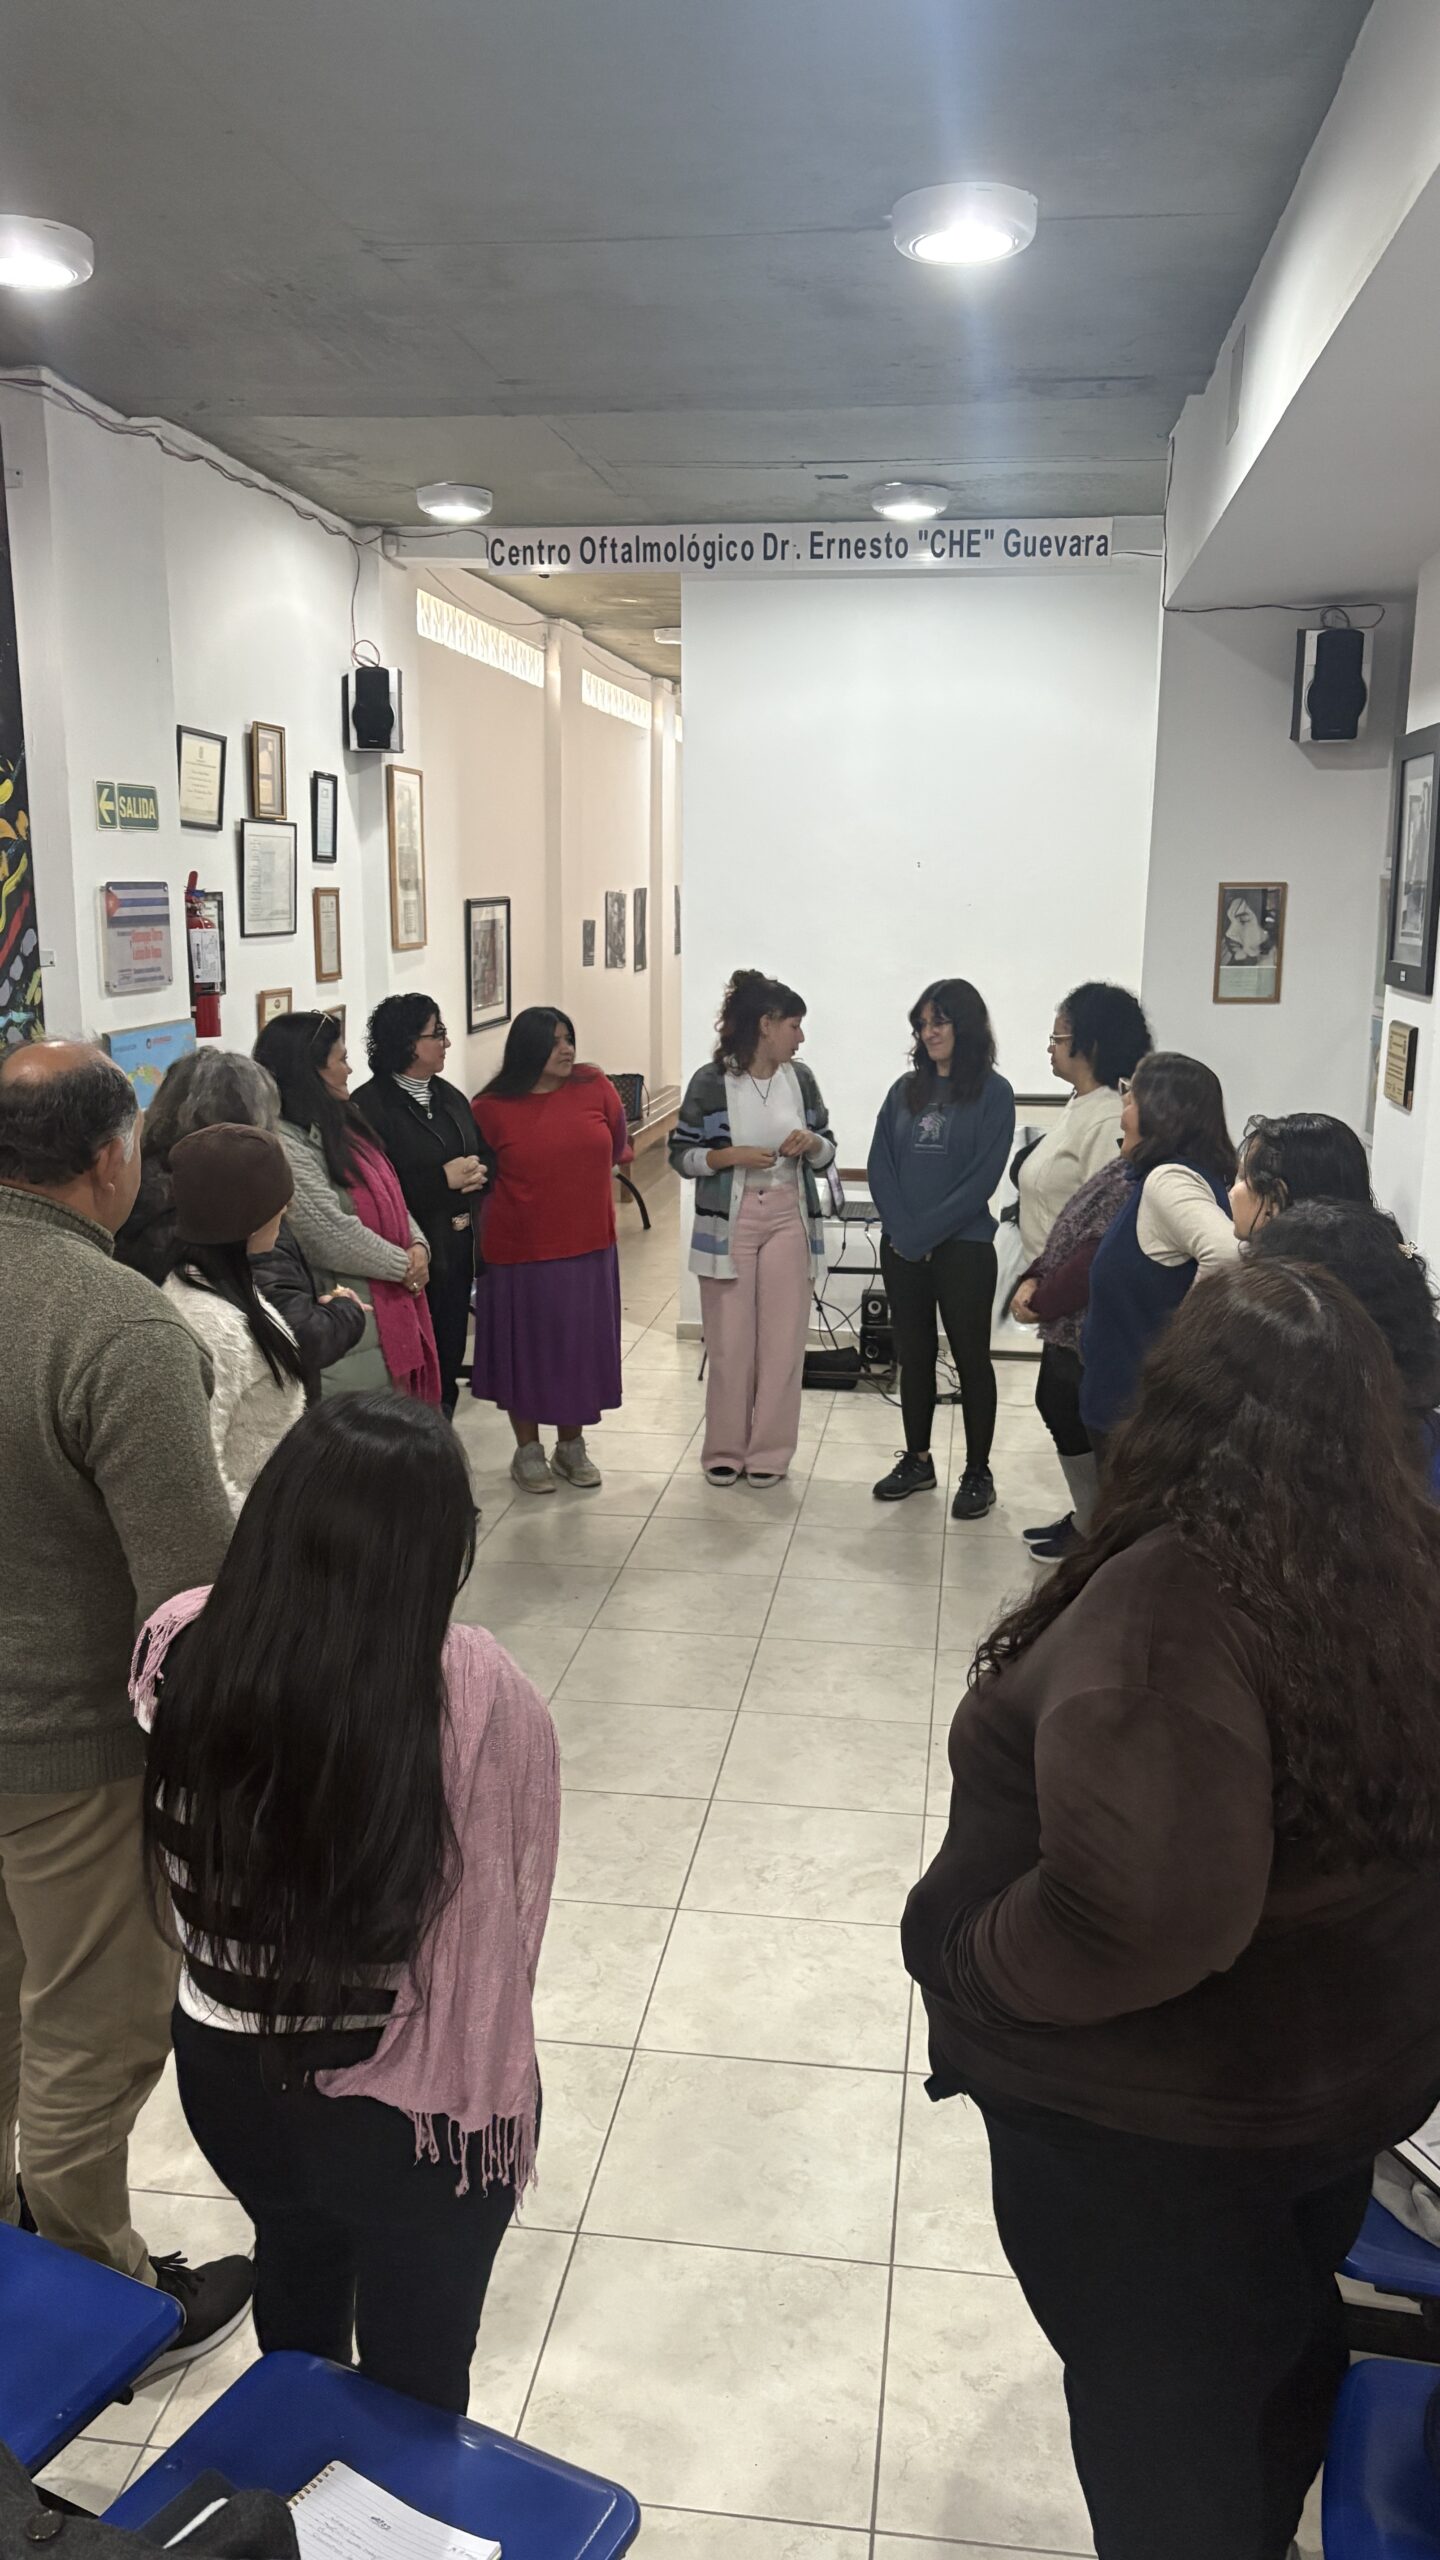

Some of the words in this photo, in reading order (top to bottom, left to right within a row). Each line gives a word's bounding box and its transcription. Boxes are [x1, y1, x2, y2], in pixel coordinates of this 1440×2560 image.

[490, 538, 571, 566] Centro
[580, 532, 755, 570] Oftalmológico
[763, 532, 801, 561] Dr.
[810, 530, 909, 560] Ernesto
[918, 528, 995, 559] "CHE"
[1003, 527, 1109, 559] Guevara
[119, 795, 157, 819] SALIDA
